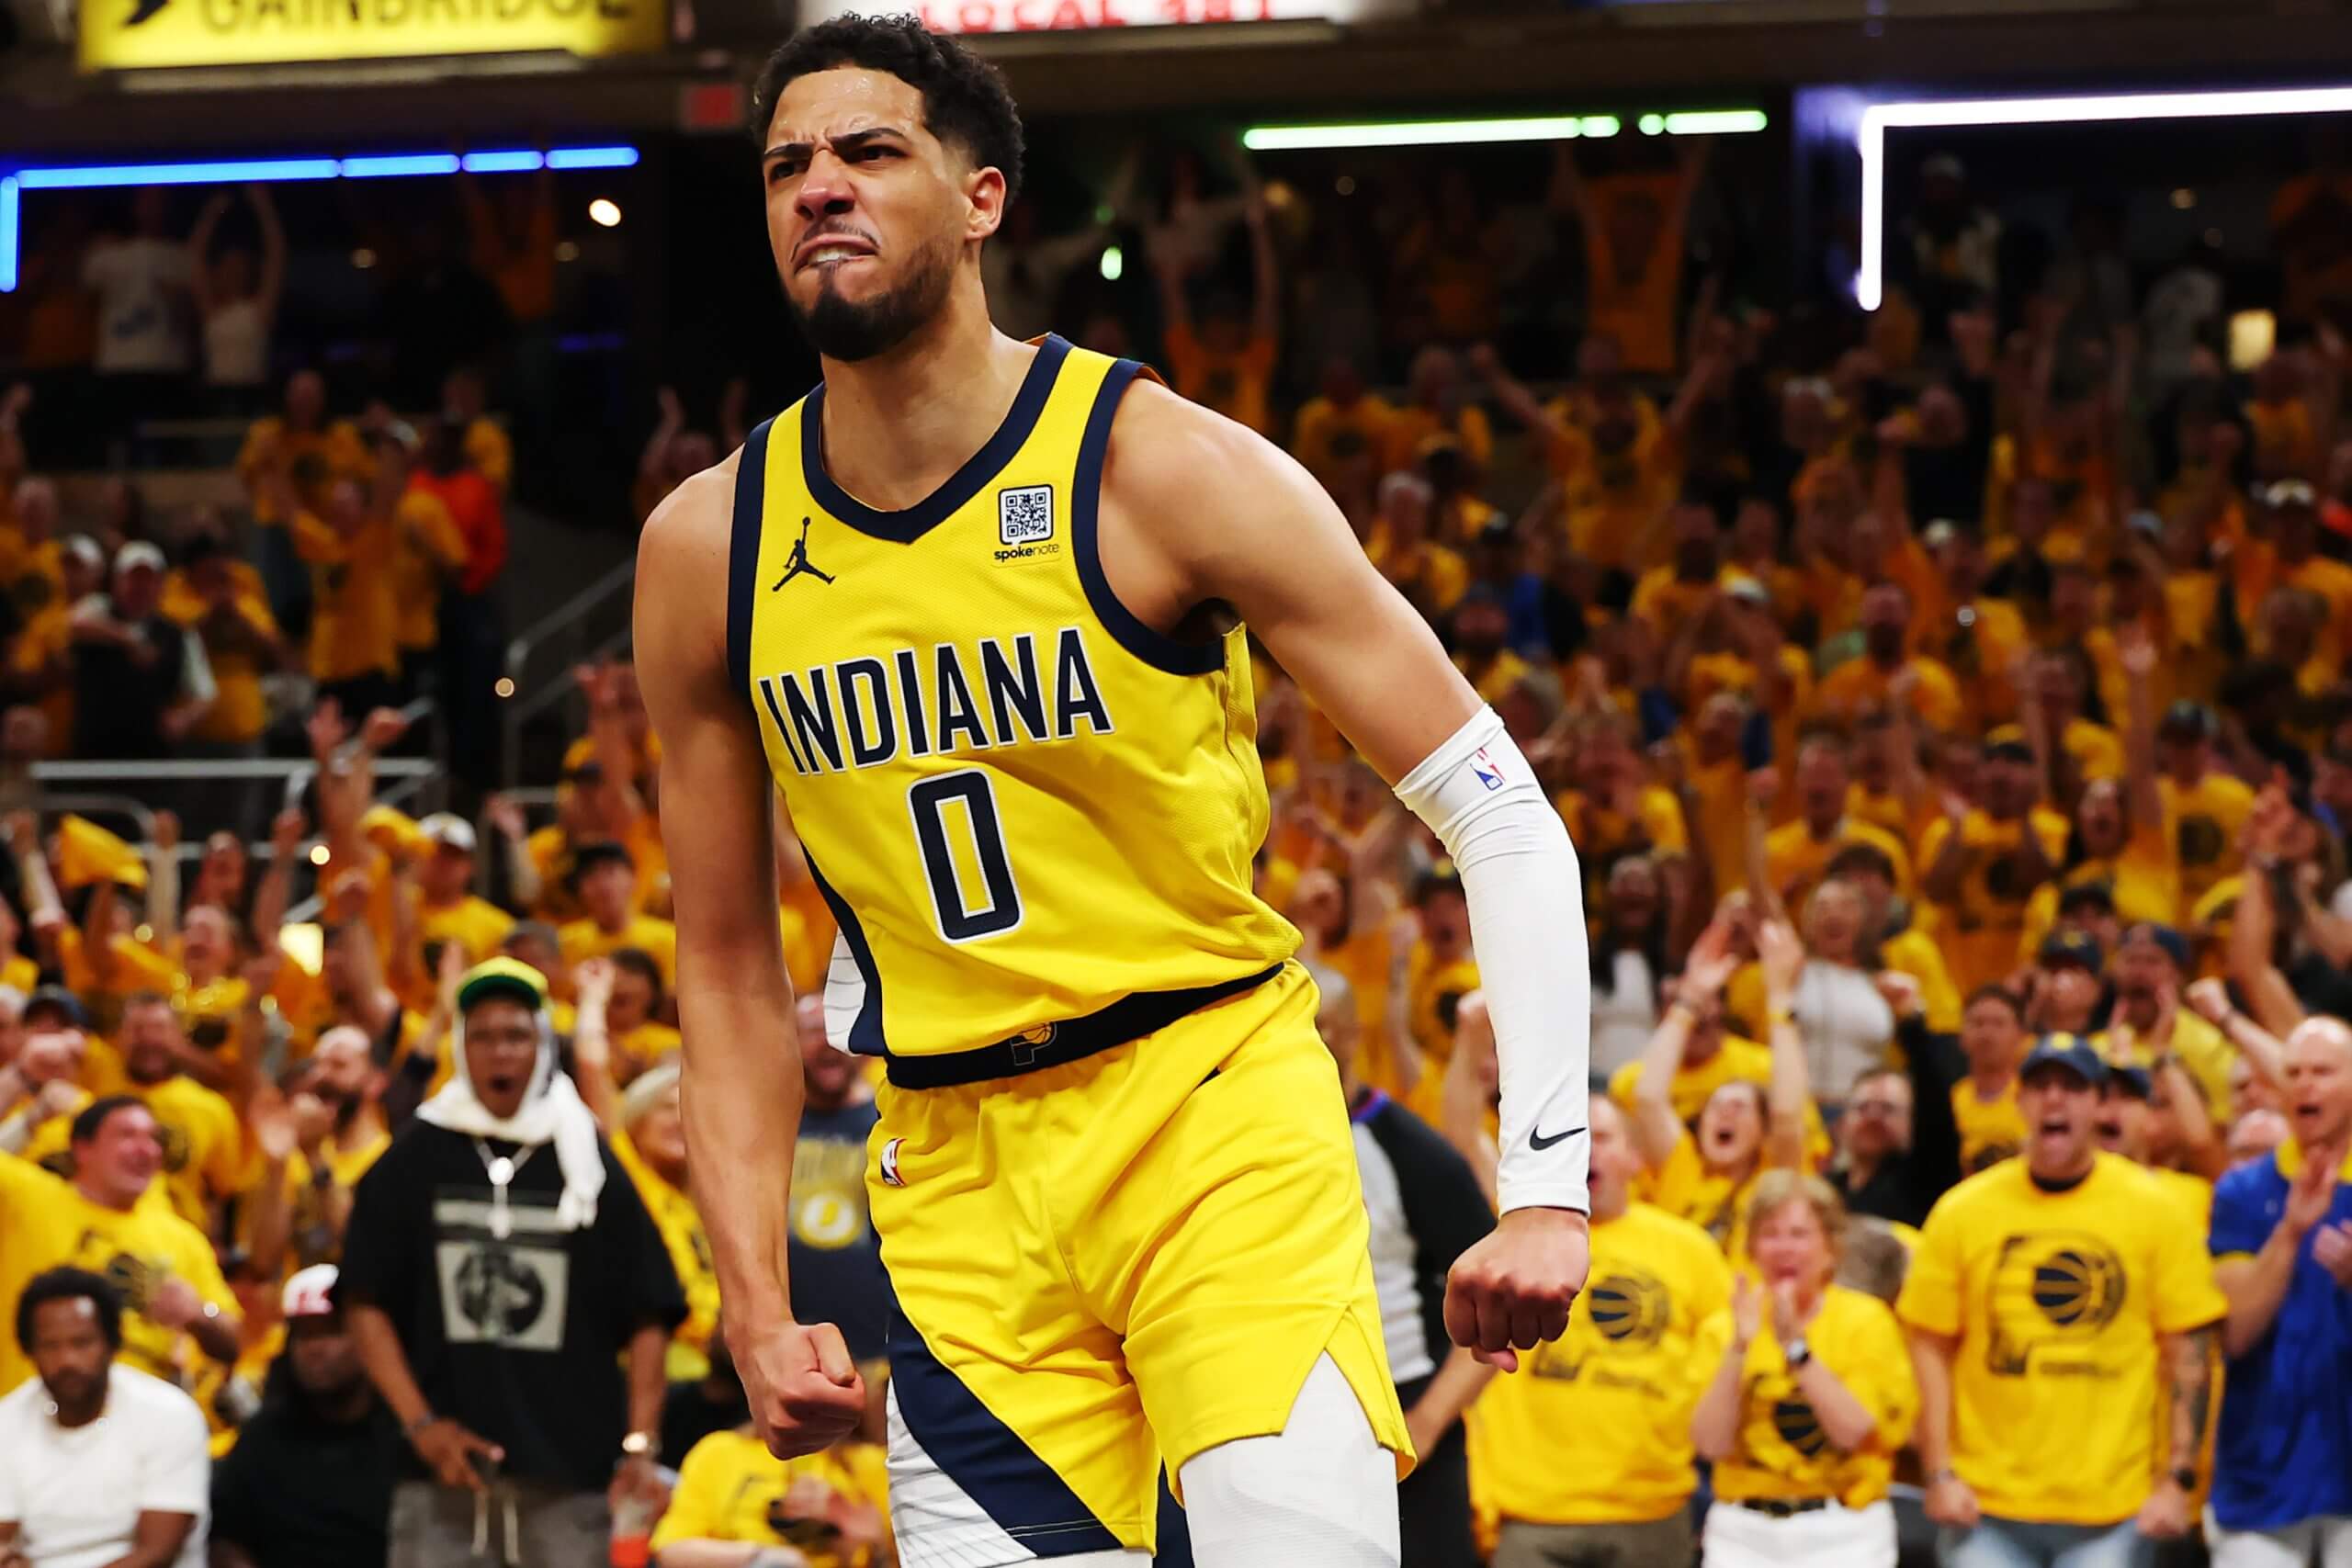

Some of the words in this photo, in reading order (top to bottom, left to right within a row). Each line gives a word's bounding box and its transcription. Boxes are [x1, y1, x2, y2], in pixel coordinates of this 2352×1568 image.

[994, 544, 1059, 562] spokenote
[759, 626, 1114, 774] INDIANA
[908, 767, 1023, 943] 0
